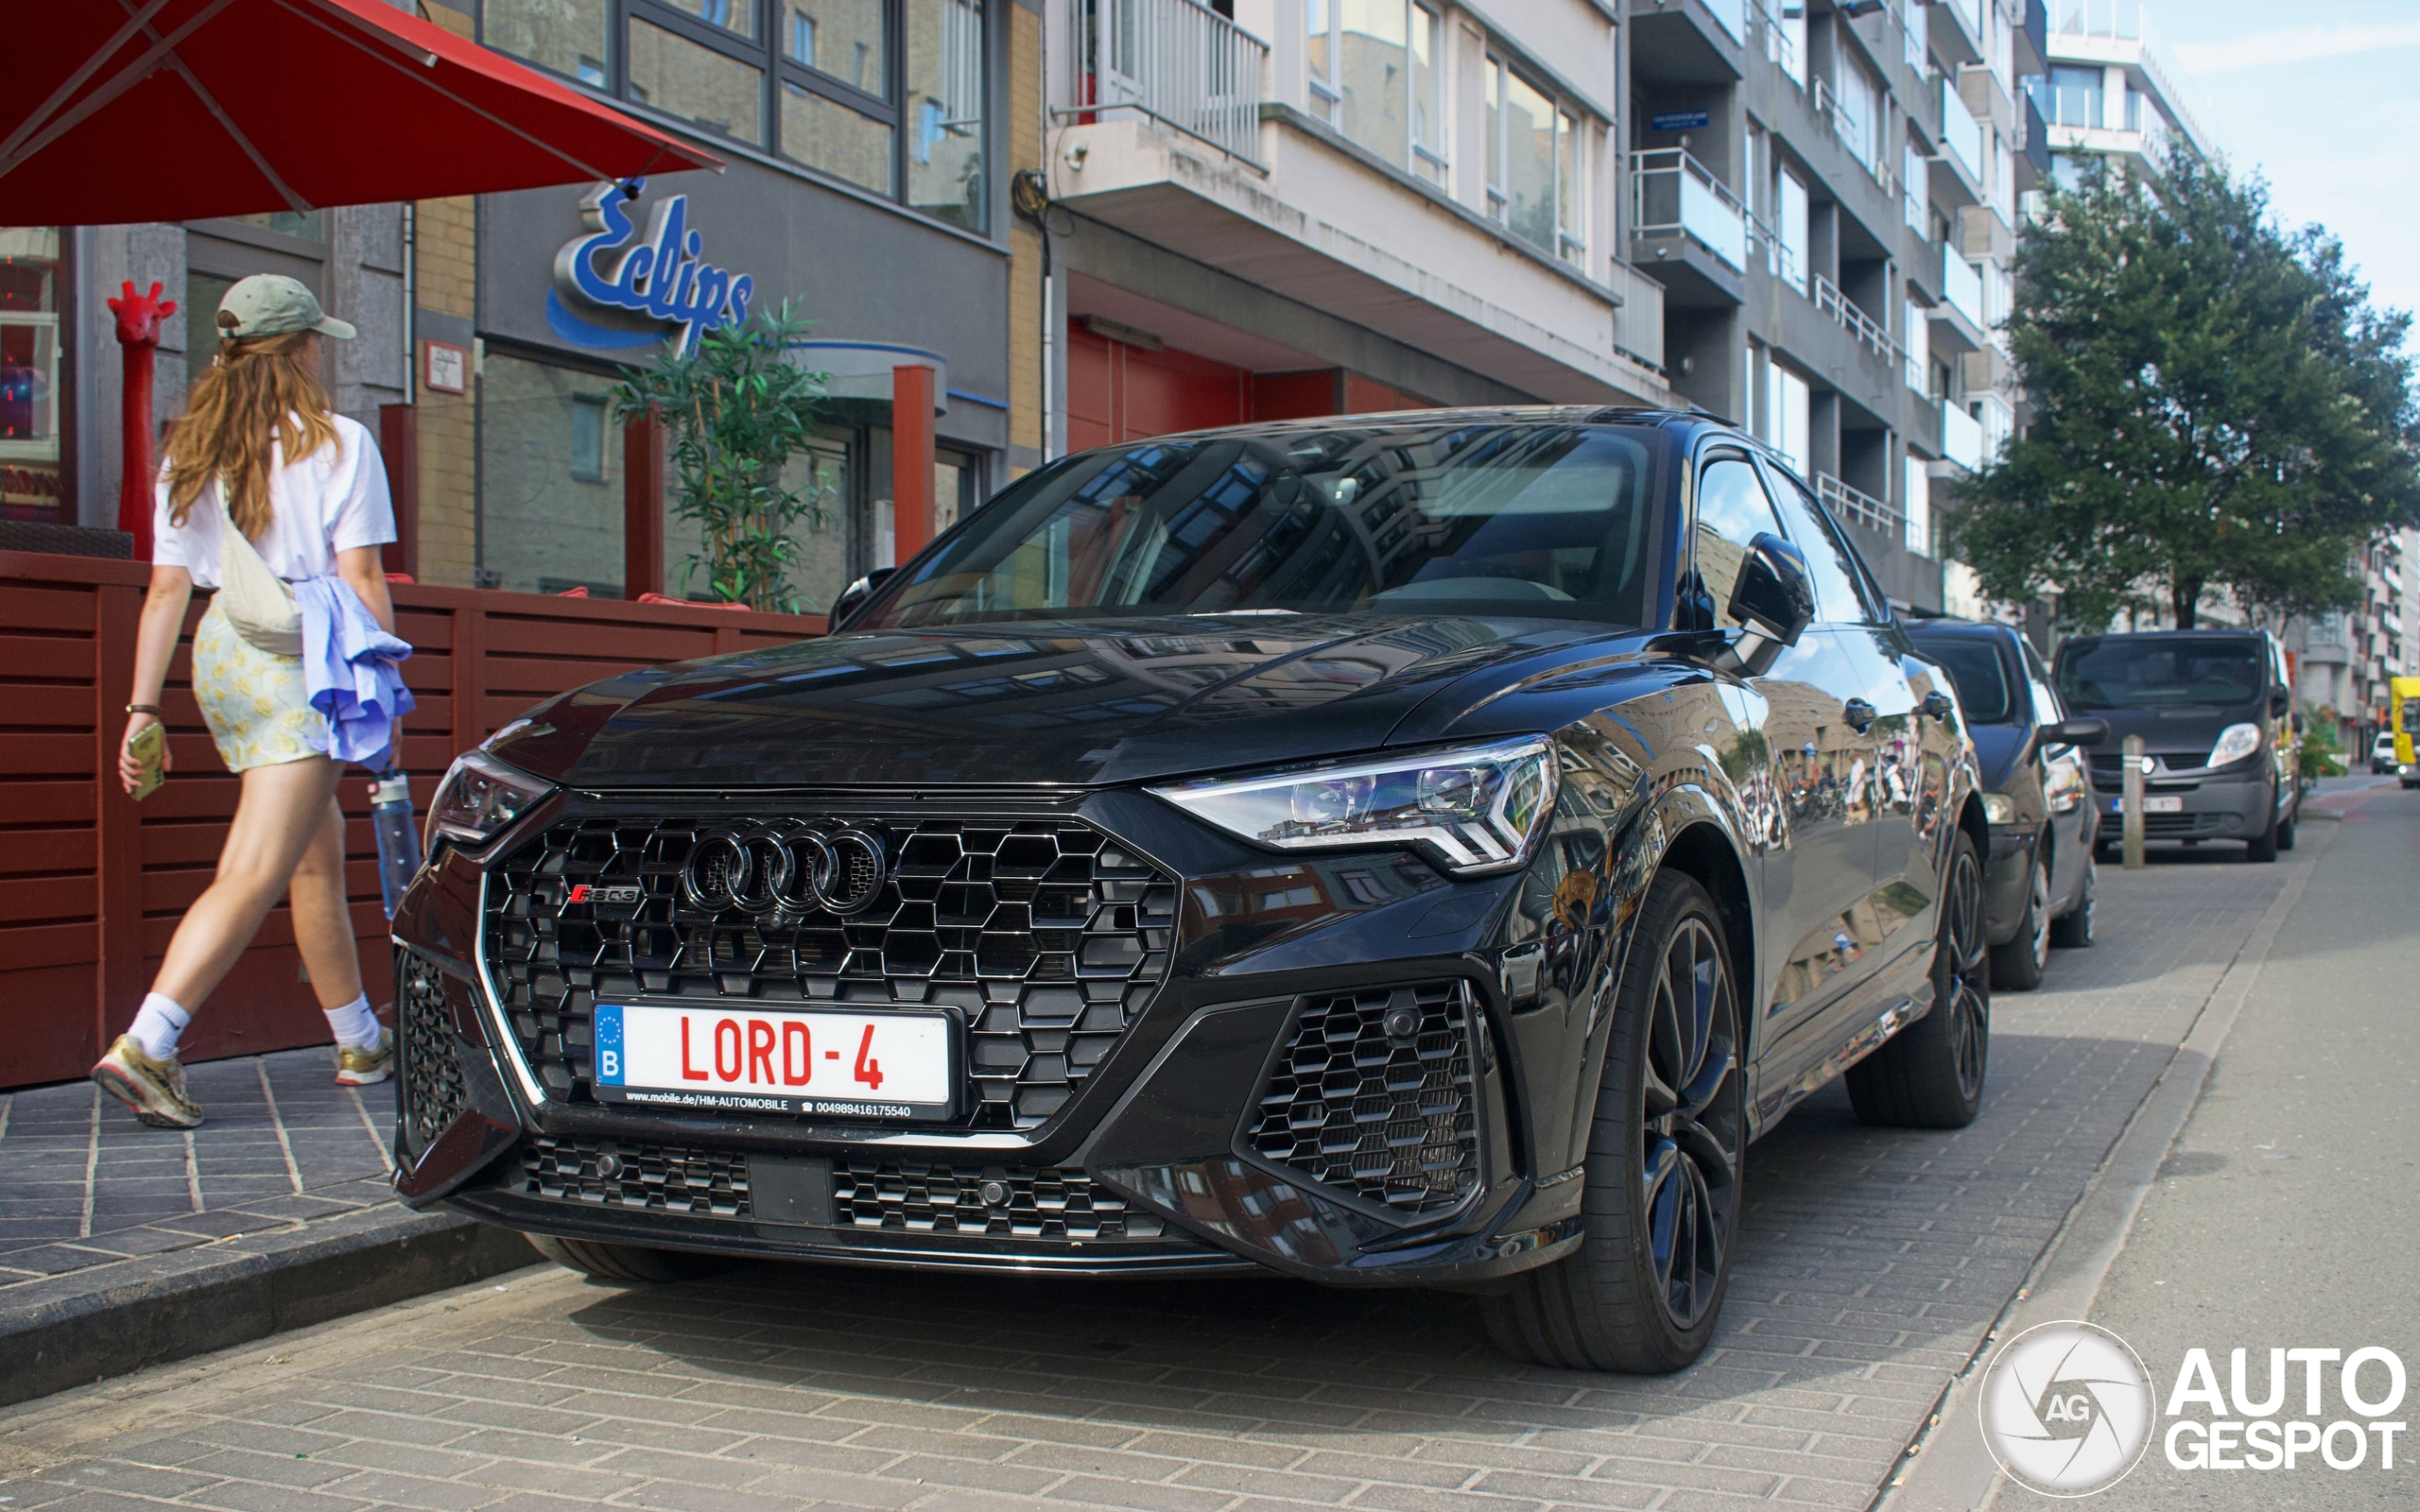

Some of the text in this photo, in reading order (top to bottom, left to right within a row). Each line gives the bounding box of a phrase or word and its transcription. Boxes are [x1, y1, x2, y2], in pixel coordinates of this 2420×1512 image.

[554, 176, 754, 361] Eclips
[602, 1050, 619, 1076] B
[626, 1091, 911, 1117] www.mobile.de/HM-AUTOMOBILE 004989416175540
